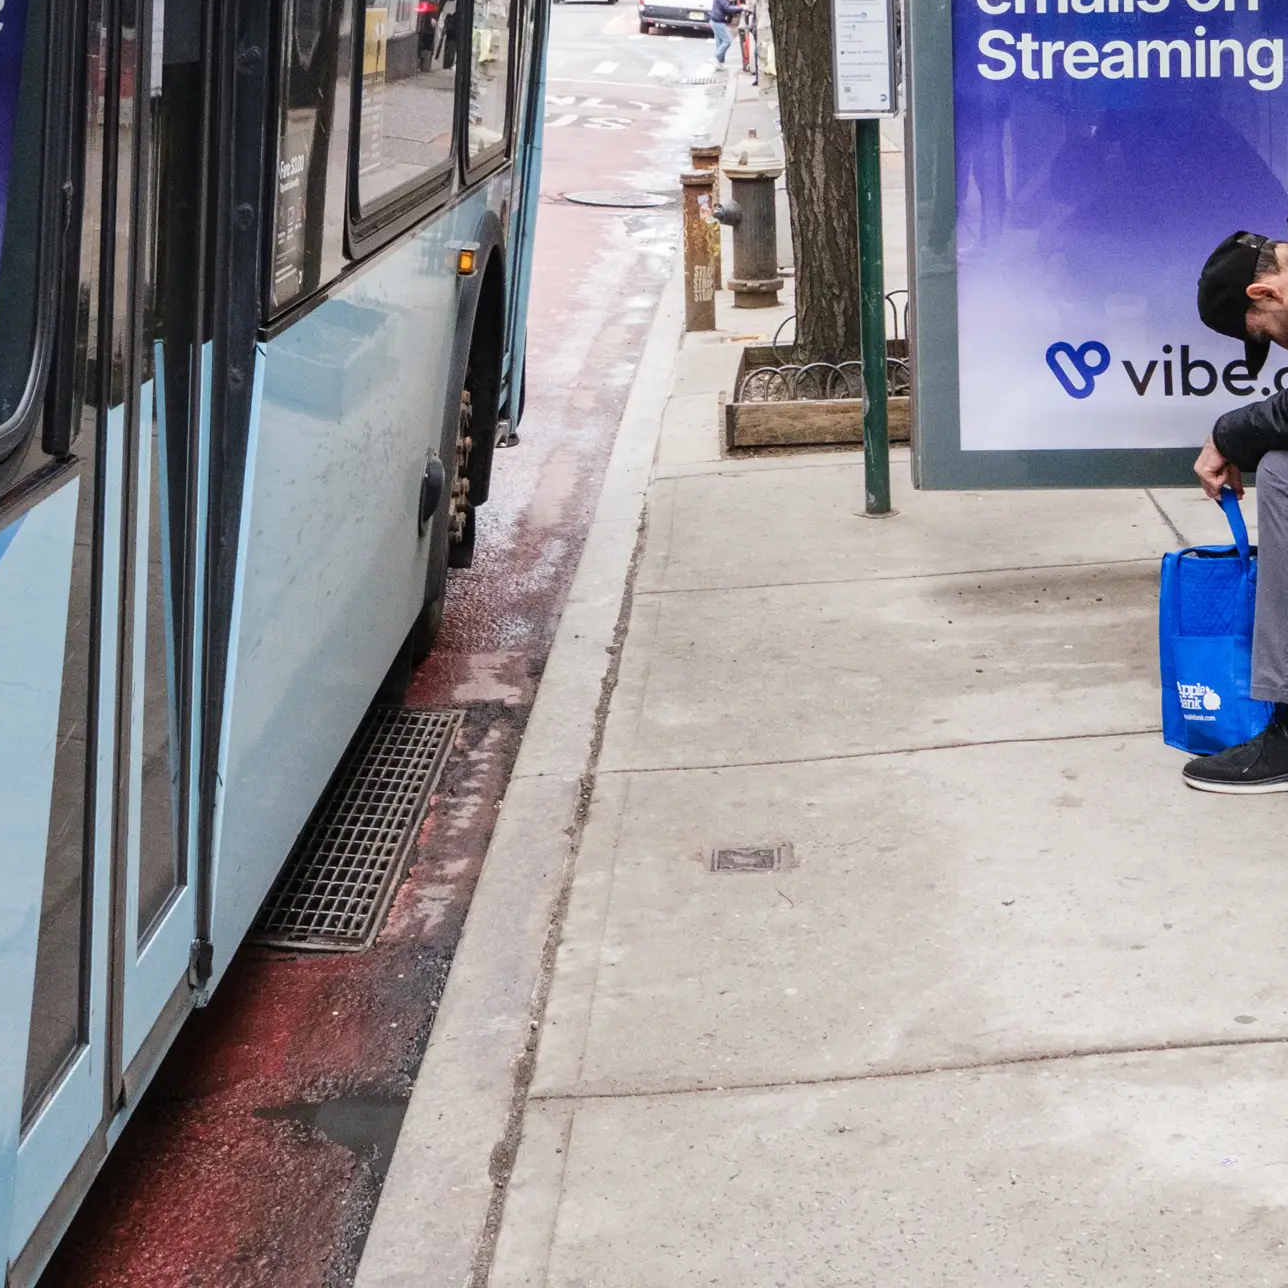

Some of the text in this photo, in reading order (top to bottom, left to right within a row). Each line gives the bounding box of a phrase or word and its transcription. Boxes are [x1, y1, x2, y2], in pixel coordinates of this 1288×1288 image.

[976, 24, 1285, 92] Streaming
[546, 93, 652, 112] NLY
[544, 113, 633, 131] US
